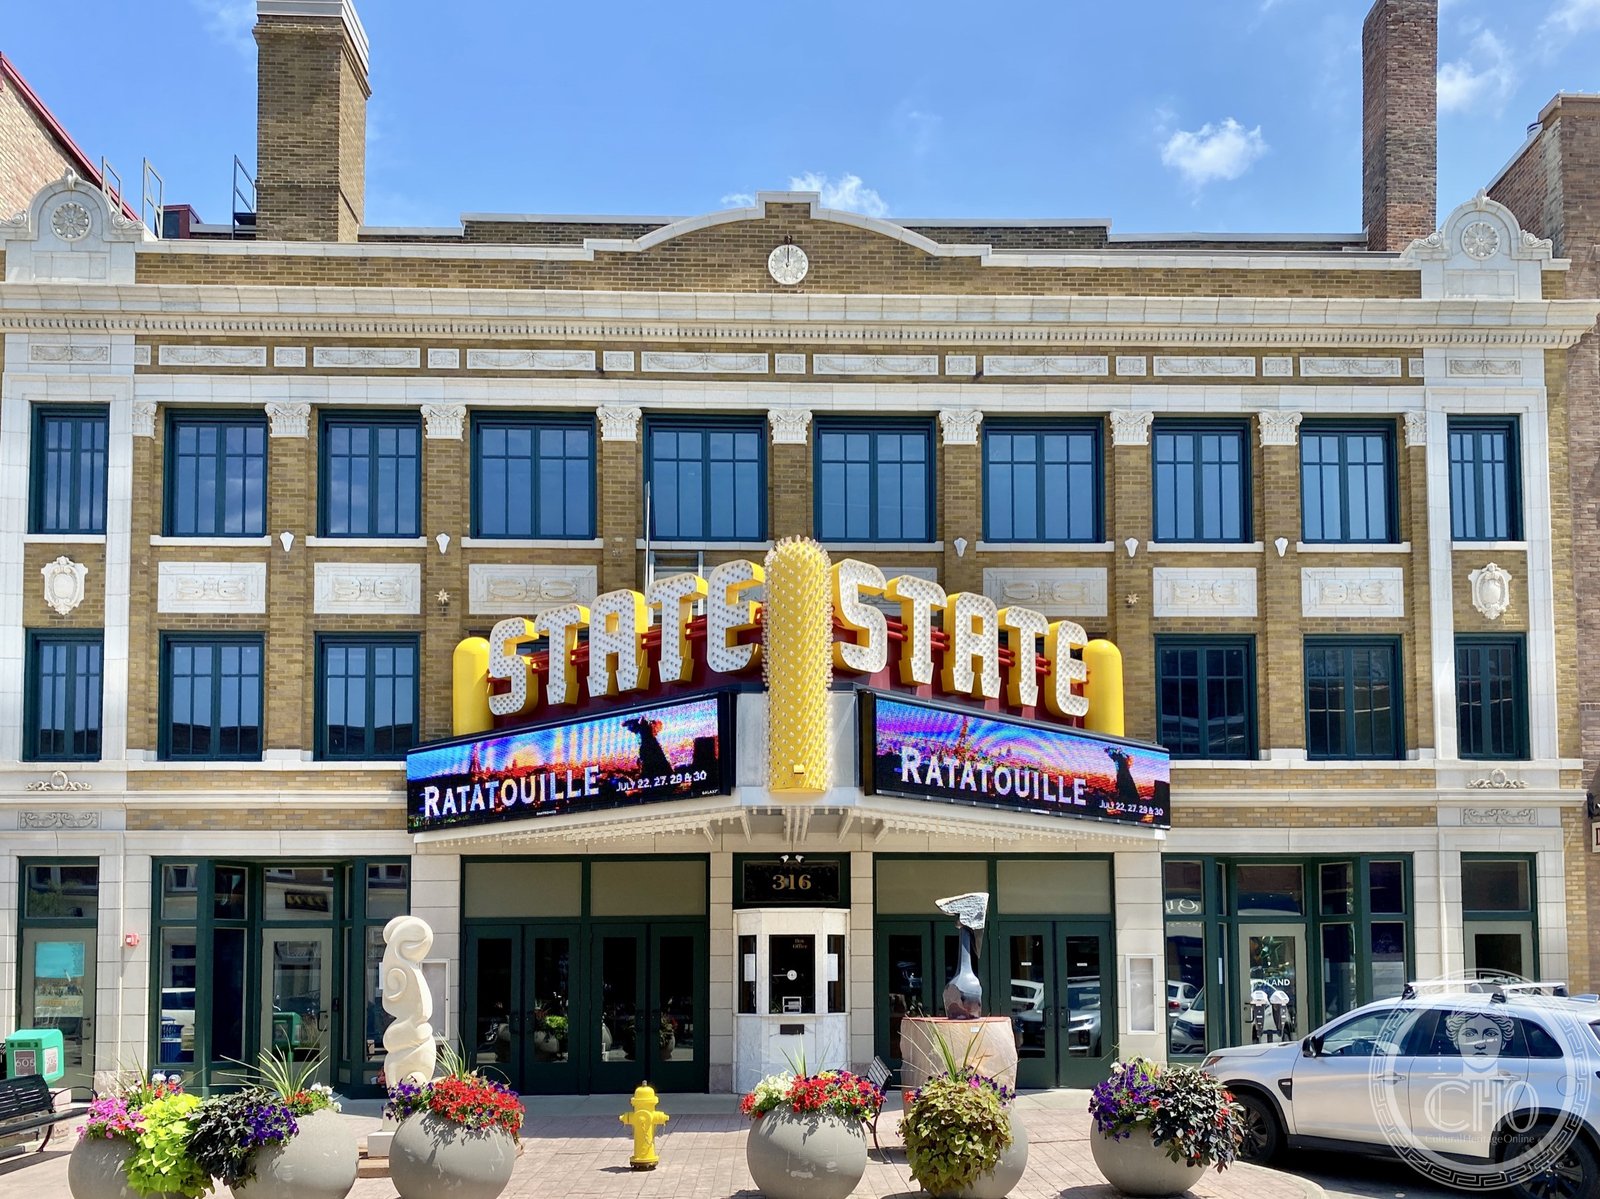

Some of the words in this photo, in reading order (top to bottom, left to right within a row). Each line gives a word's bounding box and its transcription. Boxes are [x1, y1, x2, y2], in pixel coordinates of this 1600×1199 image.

[489, 560, 764, 716] STATE
[831, 558, 1089, 718] STATE
[424, 765, 600, 818] RATATOUILLE
[693, 769, 707, 781] 30
[900, 746, 1087, 806] RATATOUILLE
[1154, 807, 1164, 816] 30
[772, 874, 812, 890] 316
